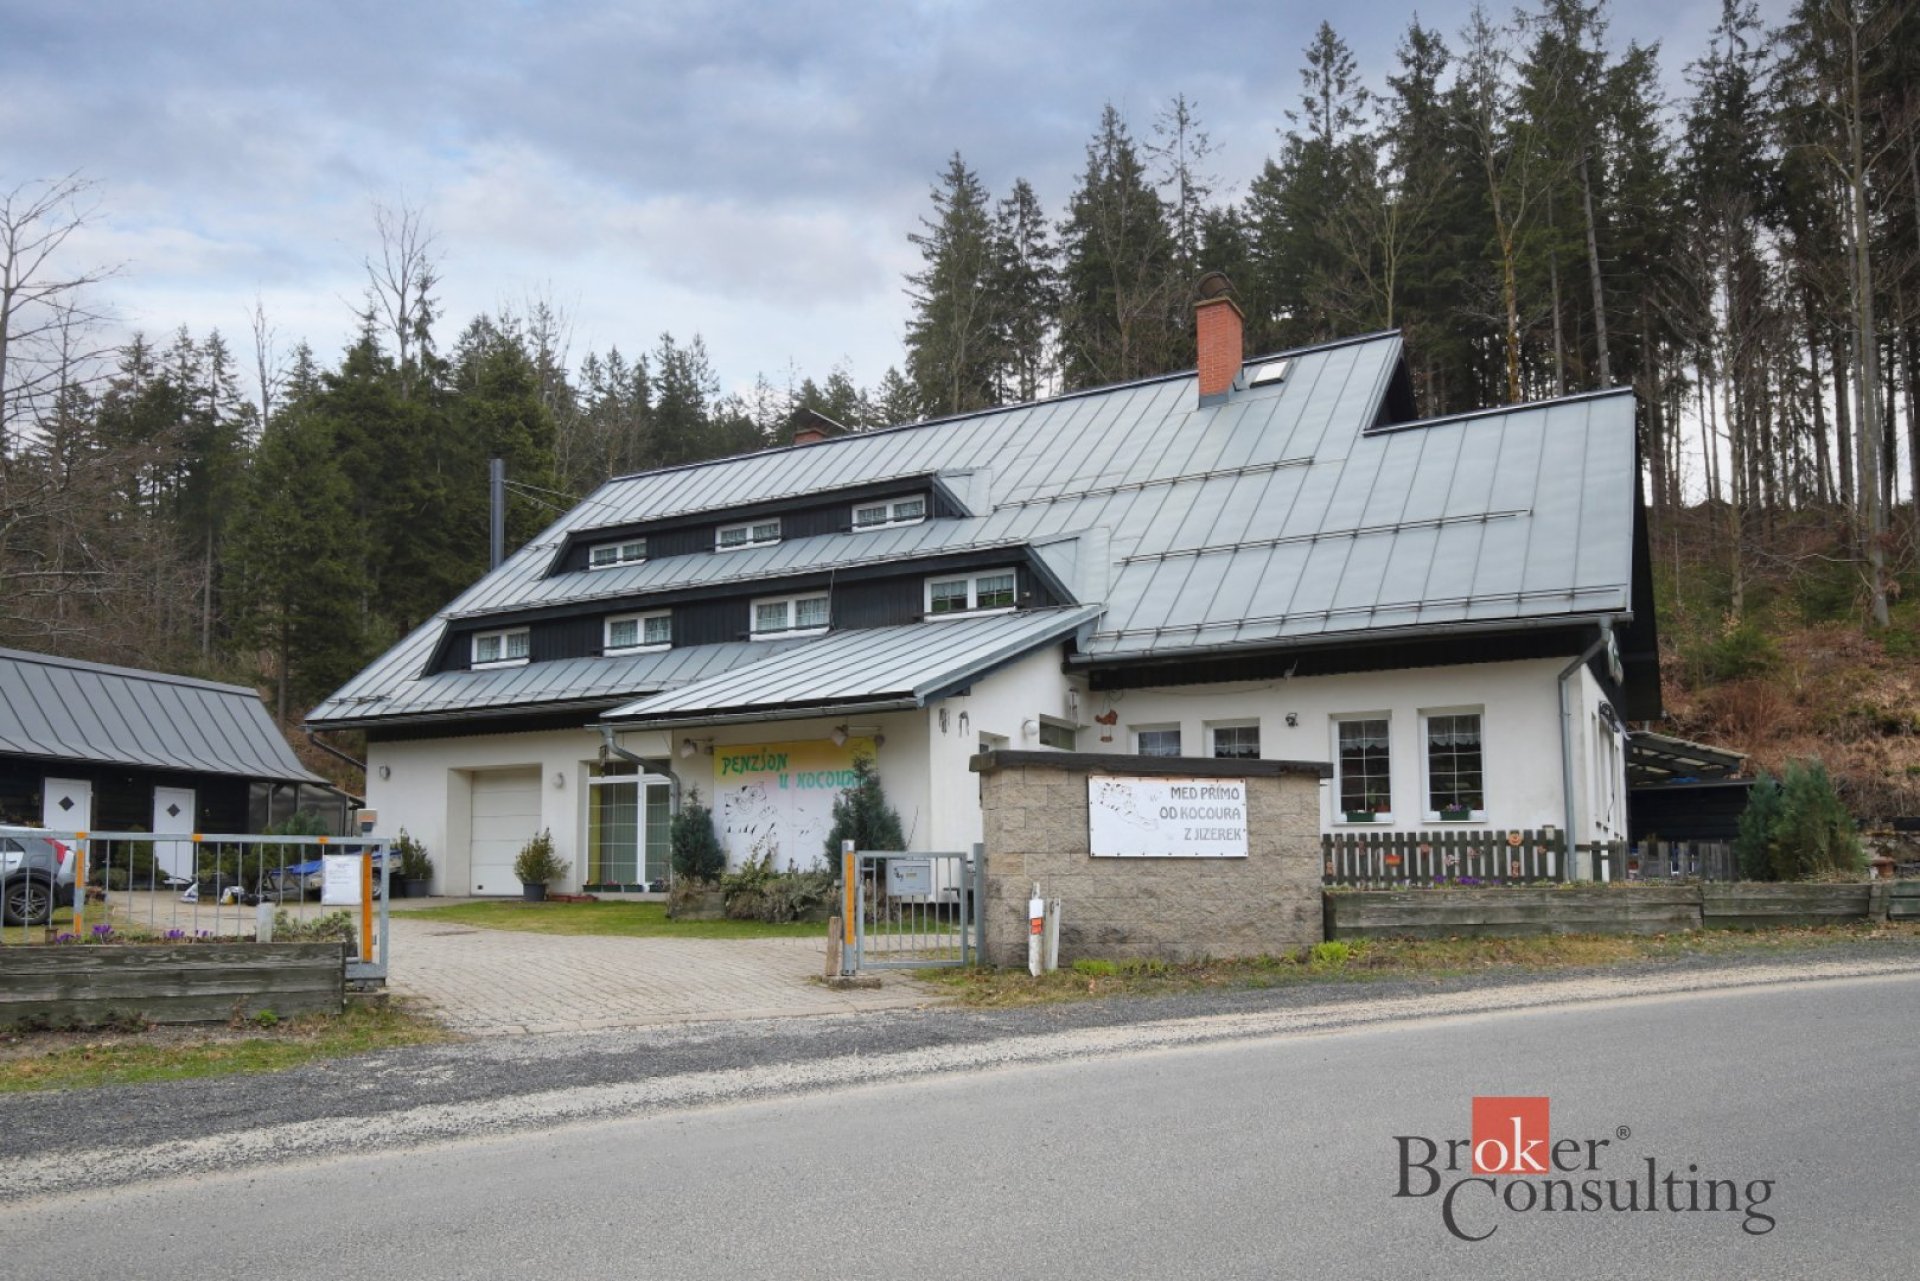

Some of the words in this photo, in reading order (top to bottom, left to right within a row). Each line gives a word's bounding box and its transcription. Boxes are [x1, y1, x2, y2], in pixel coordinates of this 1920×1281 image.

[796, 769, 868, 789] KOCOUR
[1171, 786, 1197, 800] MED
[1159, 806, 1178, 820] OD
[1180, 806, 1241, 820] KOCOURA
[1184, 827, 1192, 841] Z
[1194, 827, 1243, 841] JIZEREK
